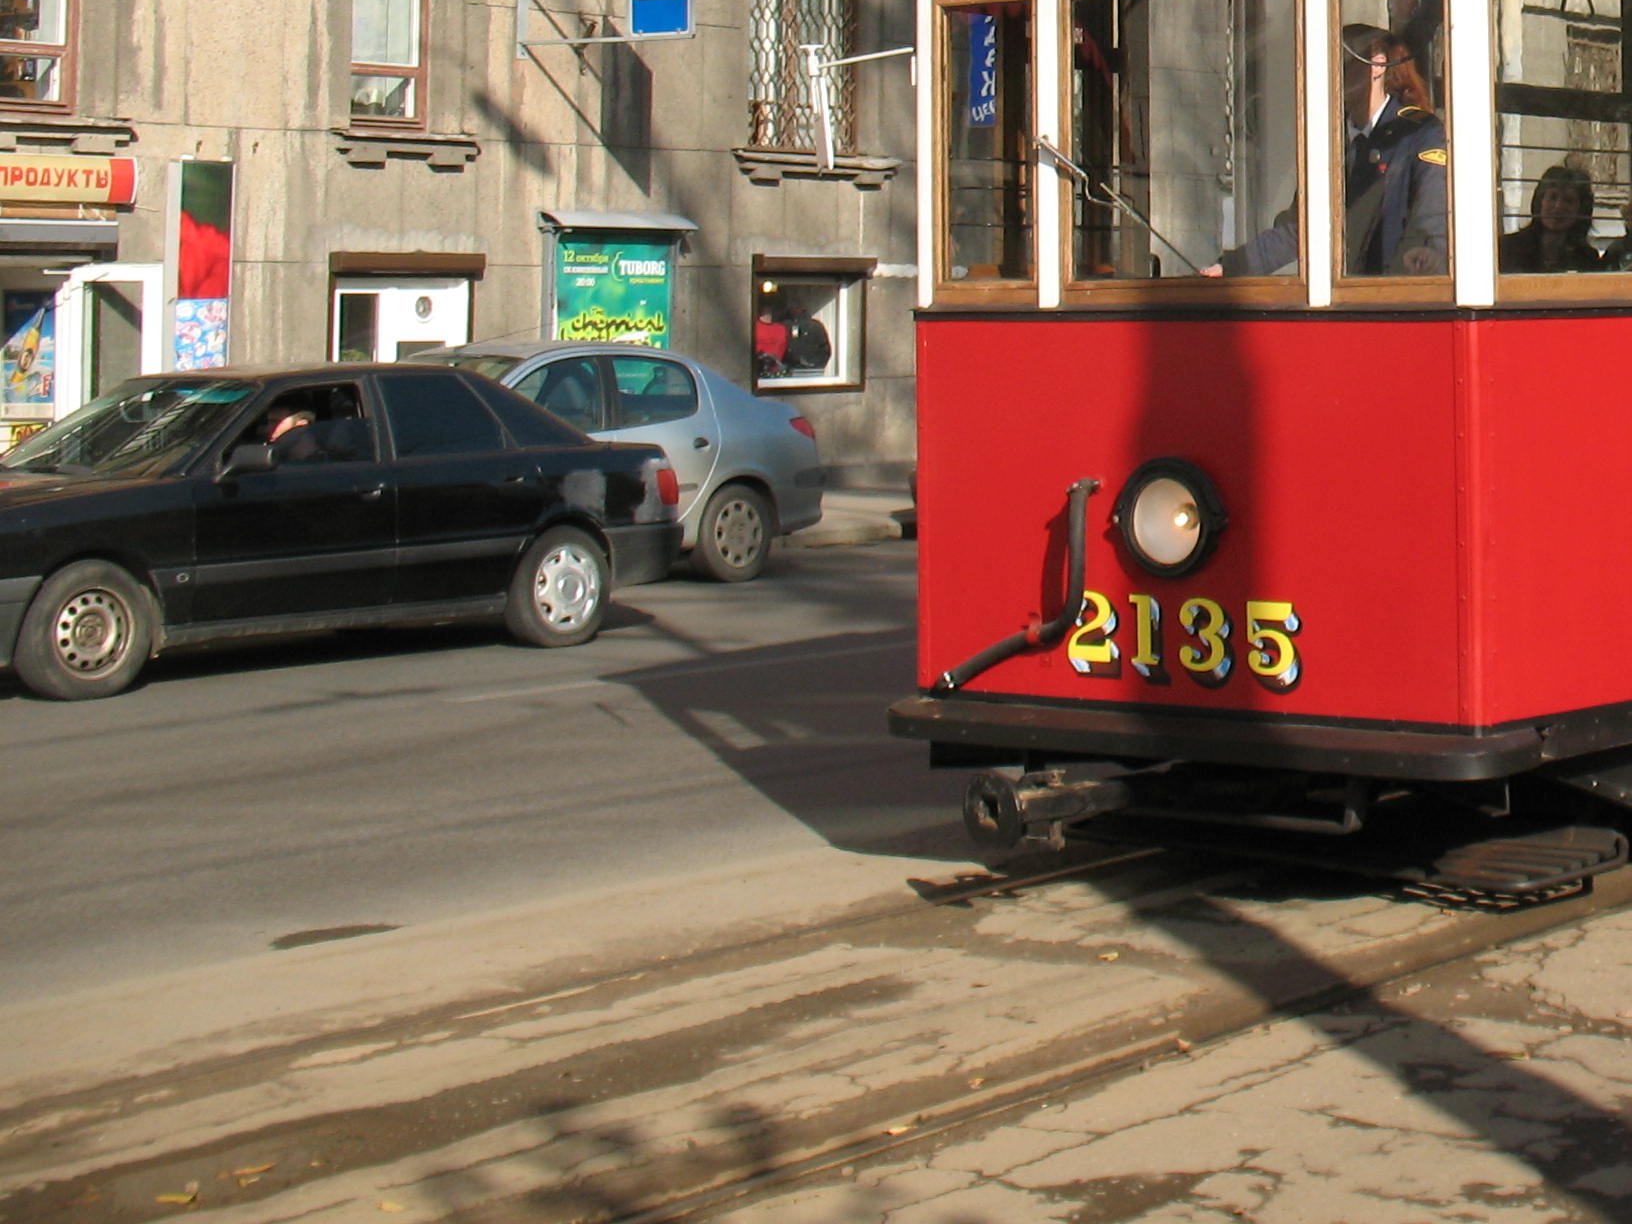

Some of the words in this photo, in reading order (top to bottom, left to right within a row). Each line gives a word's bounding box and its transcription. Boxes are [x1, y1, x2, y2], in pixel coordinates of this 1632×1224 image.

[0, 166, 109, 188] ПРОДУКТЫ
[564, 250, 575, 262] 12
[619, 260, 666, 276] TUBORG
[1067, 590, 1300, 688] 2135
